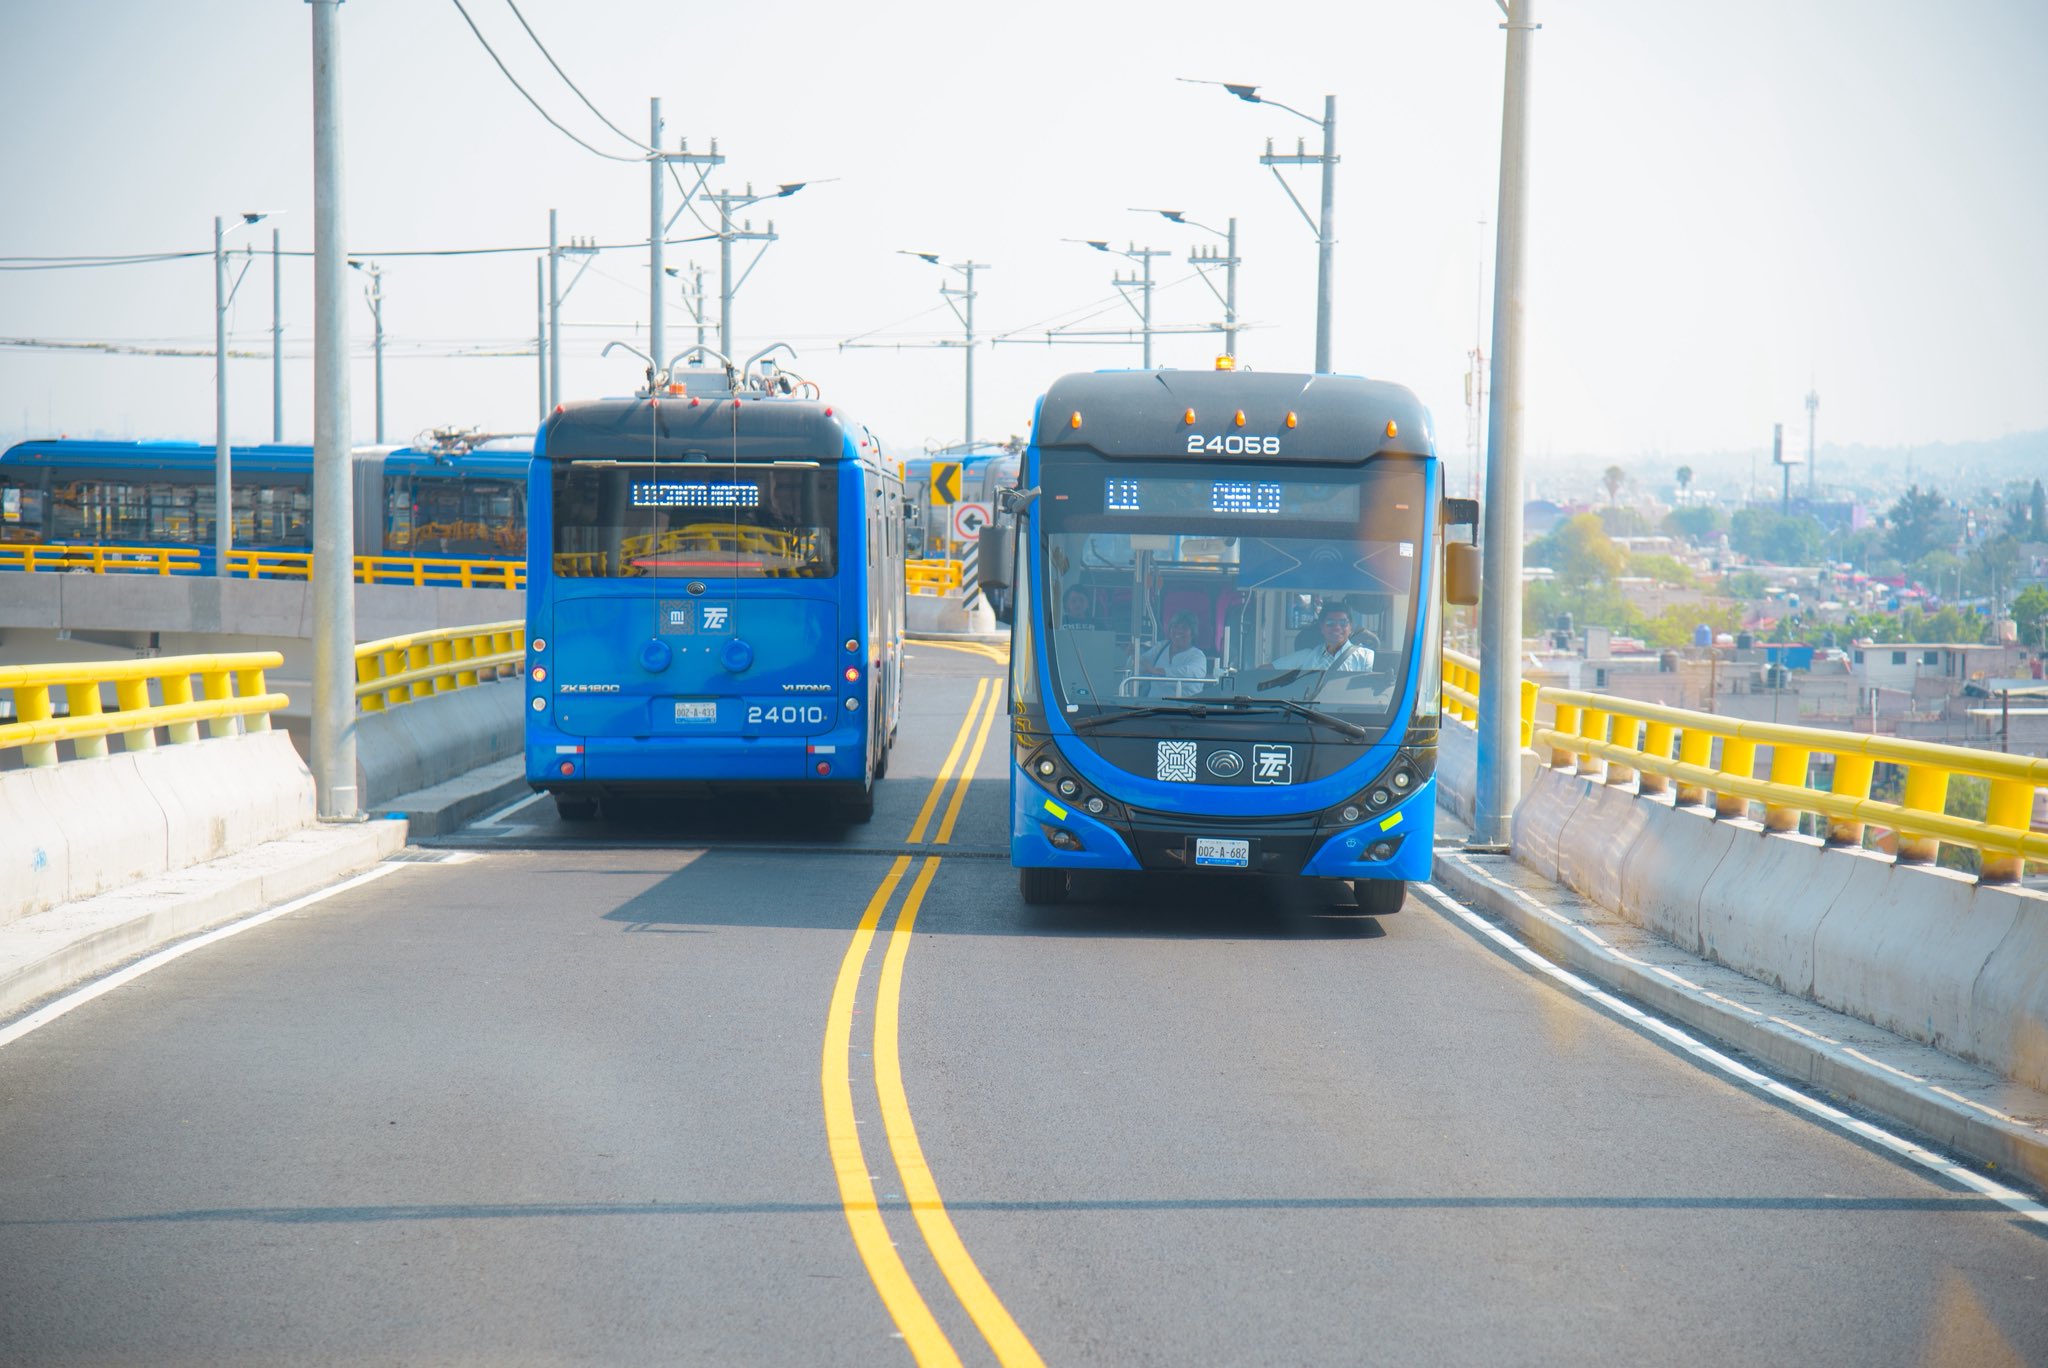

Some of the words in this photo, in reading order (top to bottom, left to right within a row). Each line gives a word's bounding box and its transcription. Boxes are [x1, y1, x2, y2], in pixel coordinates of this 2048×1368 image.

[1187, 434, 1280, 455] 24058
[1109, 480, 1140, 510] L11
[1213, 483, 1280, 513] CHALCO
[748, 706, 822, 723] 24010
[1198, 845, 1247, 859] 002-A-682
